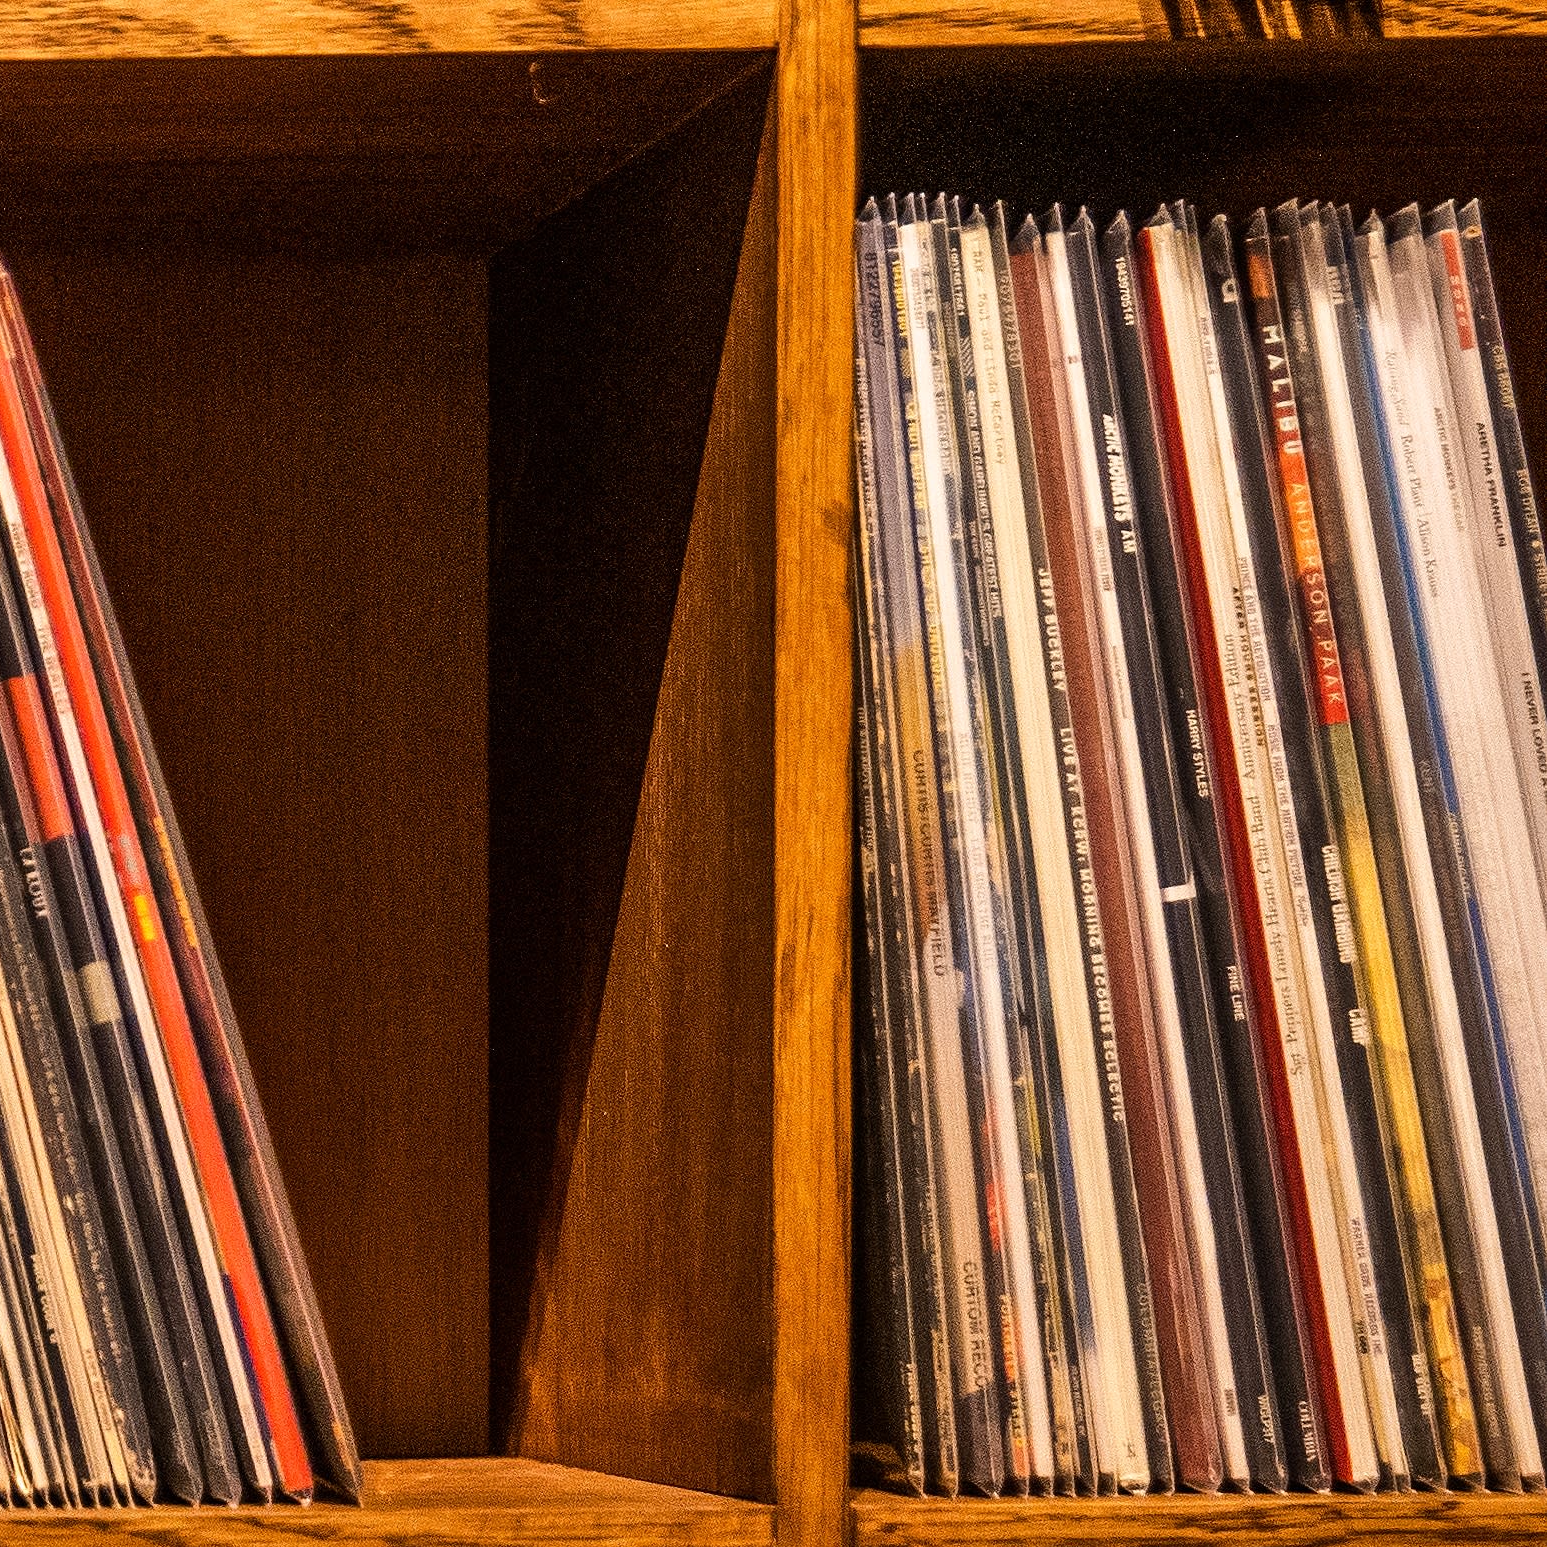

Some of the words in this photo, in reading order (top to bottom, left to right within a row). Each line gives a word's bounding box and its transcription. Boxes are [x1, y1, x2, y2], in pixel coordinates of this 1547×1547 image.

[976, 292, 989, 321] Paul
[980, 328, 993, 351] and
[983, 357, 997, 394] Linda
[1261, 324, 1302, 455] MALIBU
[963, 390, 977, 427] SIMON
[1433, 406, 1449, 441] ARCTIC
[968, 429, 979, 453] AND
[988, 400, 1005, 465] McCartney
[1100, 413, 1120, 453] ARCTIC
[1400, 434, 1418, 474] Robert
[1440, 443, 1458, 490] MONKEYS
[1107, 453, 1130, 522] MONKEYS
[1408, 477, 1425, 509] Plant
[1474, 421, 1495, 476] ARETHA
[1485, 479, 1508, 548] FRANKLIN
[1118, 528, 1135, 553] AM
[1289, 482, 1320, 579] ANDERSON
[1415, 518, 1434, 557] Alison
[1038, 568, 1056, 612] JEFF
[1237, 556, 1253, 590] PRINCE
[1423, 559, 1442, 598] Krauss
[1243, 594, 1257, 617] AND
[1247, 617, 1260, 637] THE
[1044, 613, 1066, 693] BUCKLEY
[1220, 633, 1242, 687] Edition
[1251, 640, 1271, 701] REVOLUTION
[1521, 679, 1540, 725] NEVER
[1059, 727, 1076, 766] LIVE
[1184, 708, 1202, 750] HARRY
[1231, 694, 1256, 780] Anniversary
[1265, 724, 1280, 753] MUSIC
[1270, 755, 1285, 783] FROM
[1530, 728, 1547, 773] LOVED
[1065, 771, 1080, 793] AT
[1191, 751, 1210, 798] STYLES
[1275, 785, 1289, 806] THE
[1077, 868, 1100, 948] MORNING
[1261, 880, 1280, 926] Hearts
[923, 891, 946, 977] MAYFIELD
[1319, 844, 1345, 901] CHILDISH
[1346, 1007, 1369, 1047] CAMP
[1088, 953, 1111, 1034] BECOMES
[1225, 964, 1240, 992] FINE
[1229, 993, 1245, 1021] LINE
[1099, 1039, 1123, 1122] ECLECTIC
